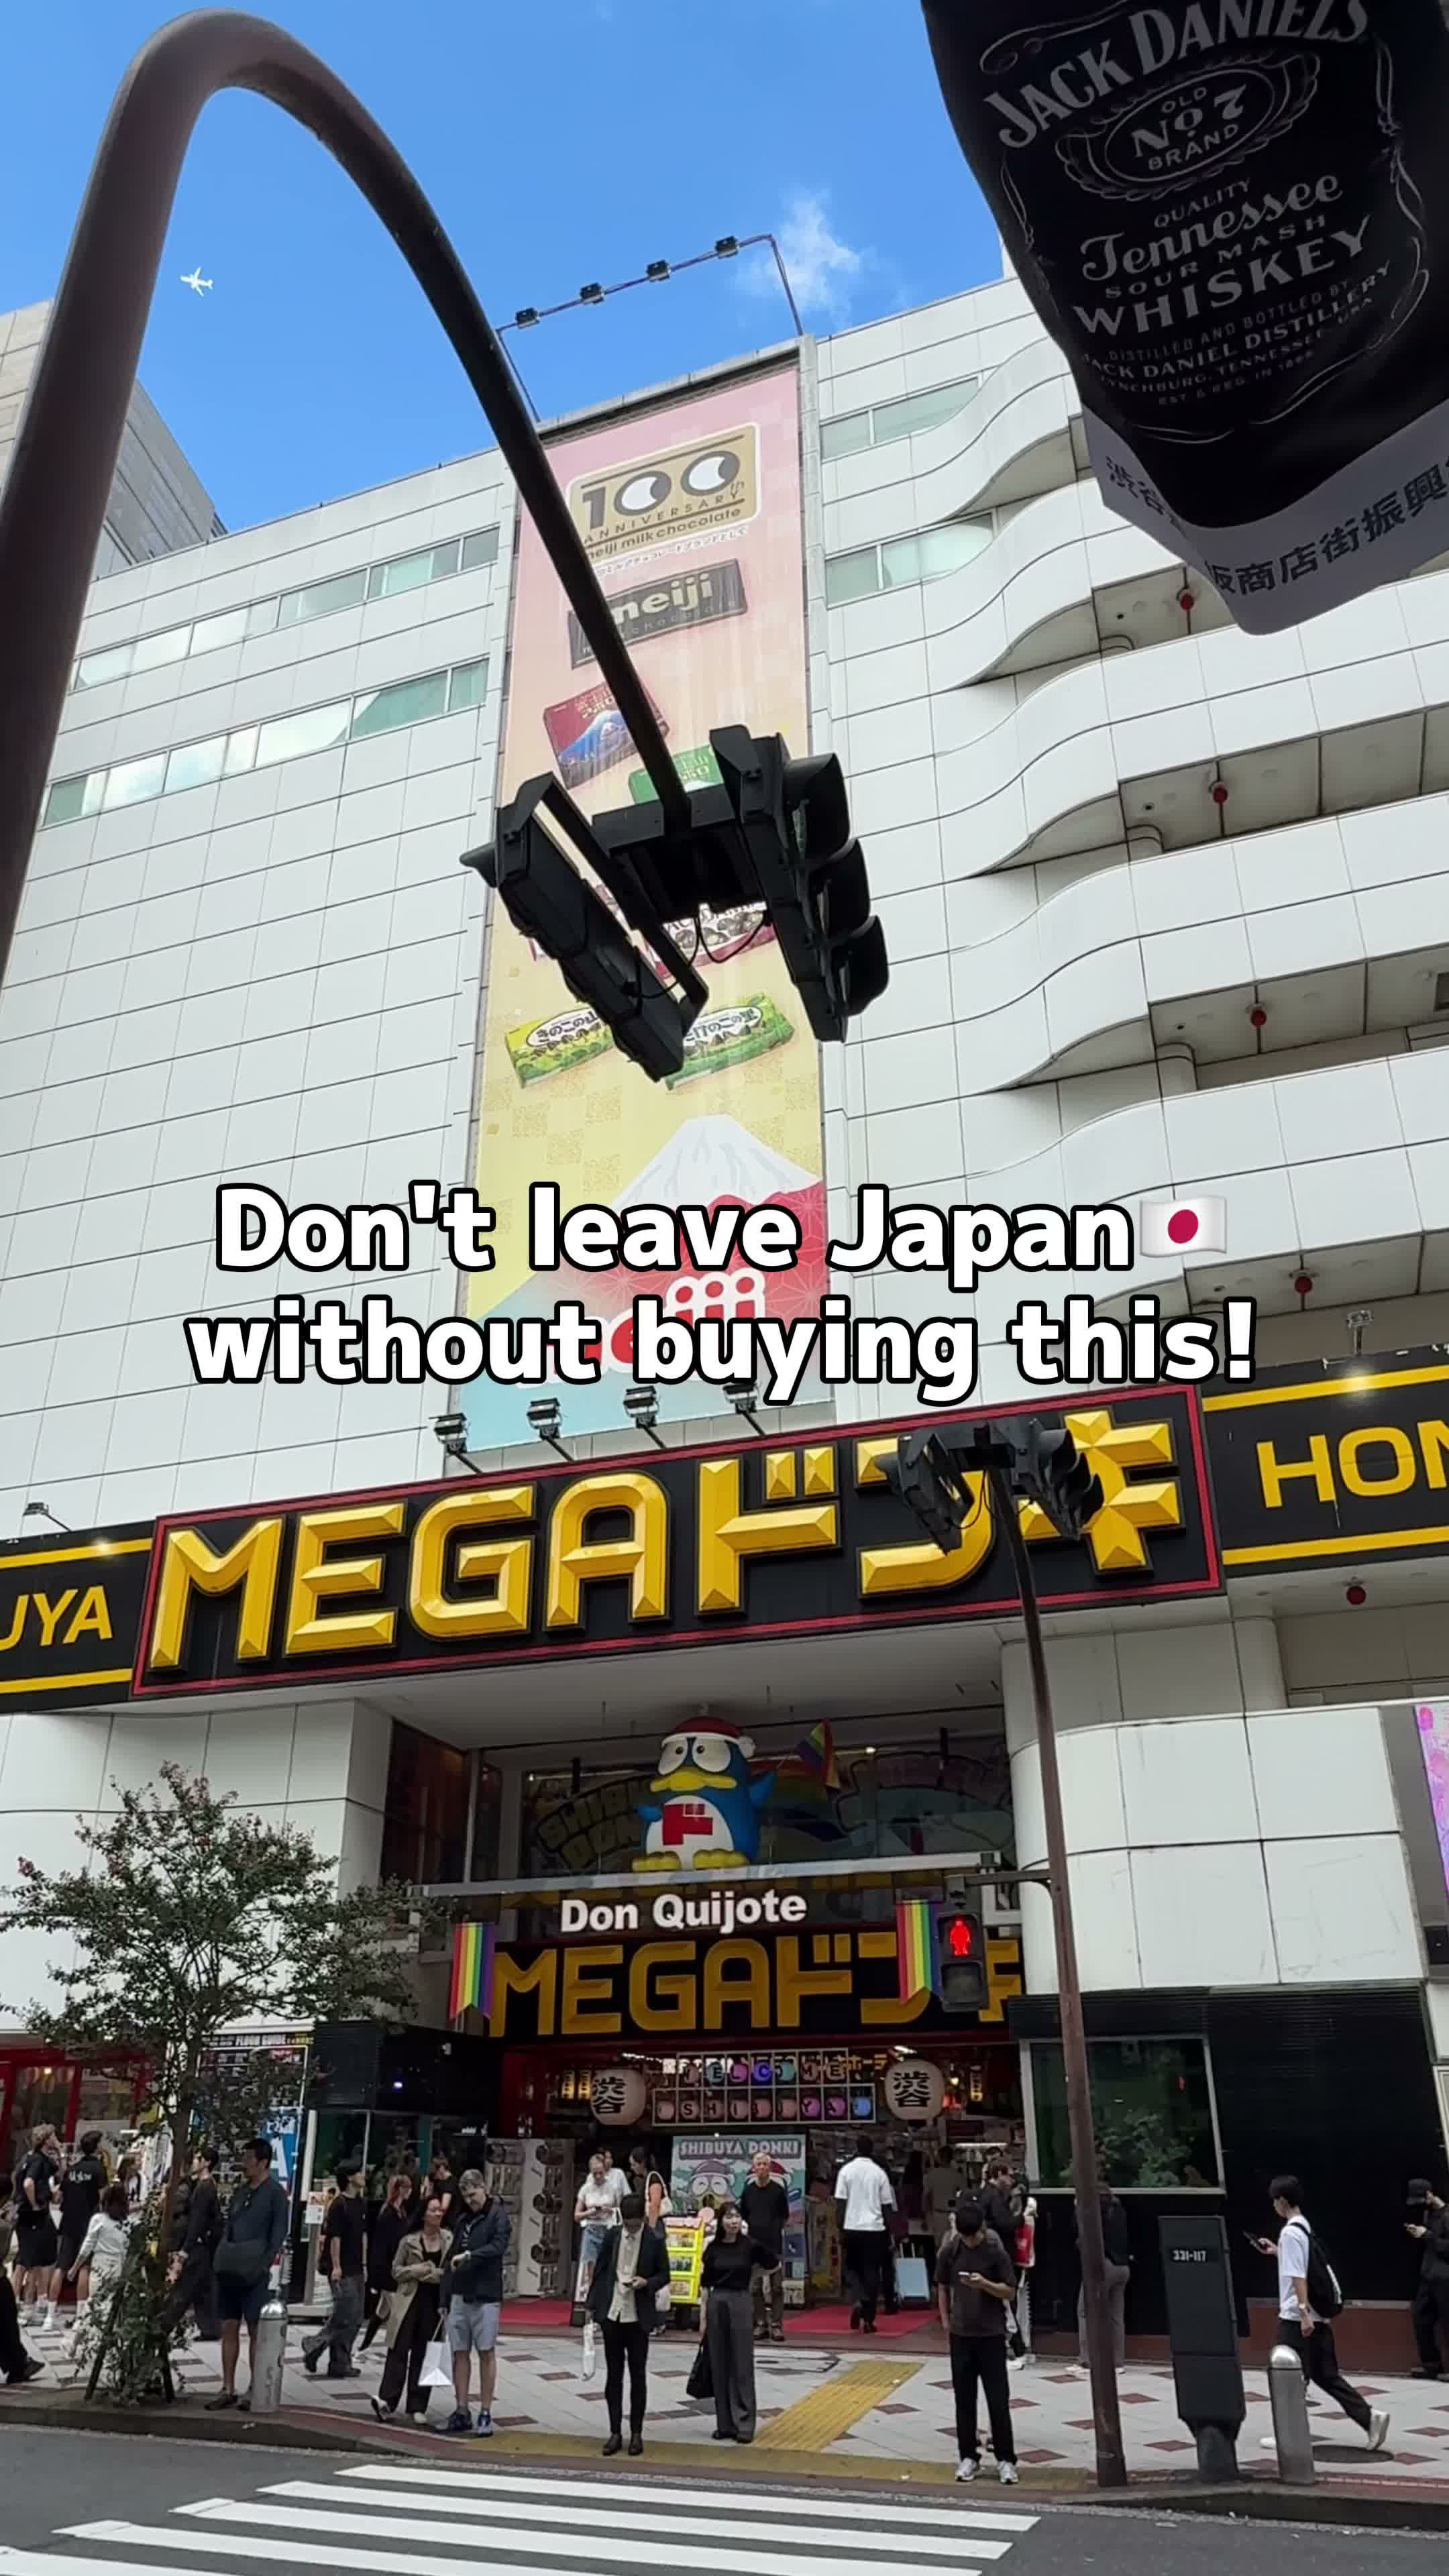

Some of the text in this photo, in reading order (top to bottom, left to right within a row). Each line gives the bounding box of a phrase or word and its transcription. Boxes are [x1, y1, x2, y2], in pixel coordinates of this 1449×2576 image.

[983, 39, 1134, 148] JACK
[1161, 86, 1209, 114] OLD
[1148, 123, 1239, 171] BRAND
[1080, 174, 1343, 281] Tennessee
[1154, 178, 1251, 228] QUALITY
[1073, 214, 1371, 335] WHISKEY
[1105, 214, 1326, 298] SOUR MASH
[1109, 278, 1350, 361] DISTILLED AND BOTTLED BY
[1143, 343, 1239, 379] DANIEL
[1245, 260, 1391, 350] DISTILLERY
[582, 450, 741, 530] 100
[584, 488, 741, 545] ANNIVERSARY
[621, 530, 655, 549] milk
[656, 507, 741, 538] chocolate
[561, 1886, 808, 1934] Don Quijote
[679, 2139, 800, 2157] SHIBUYA DONKI
